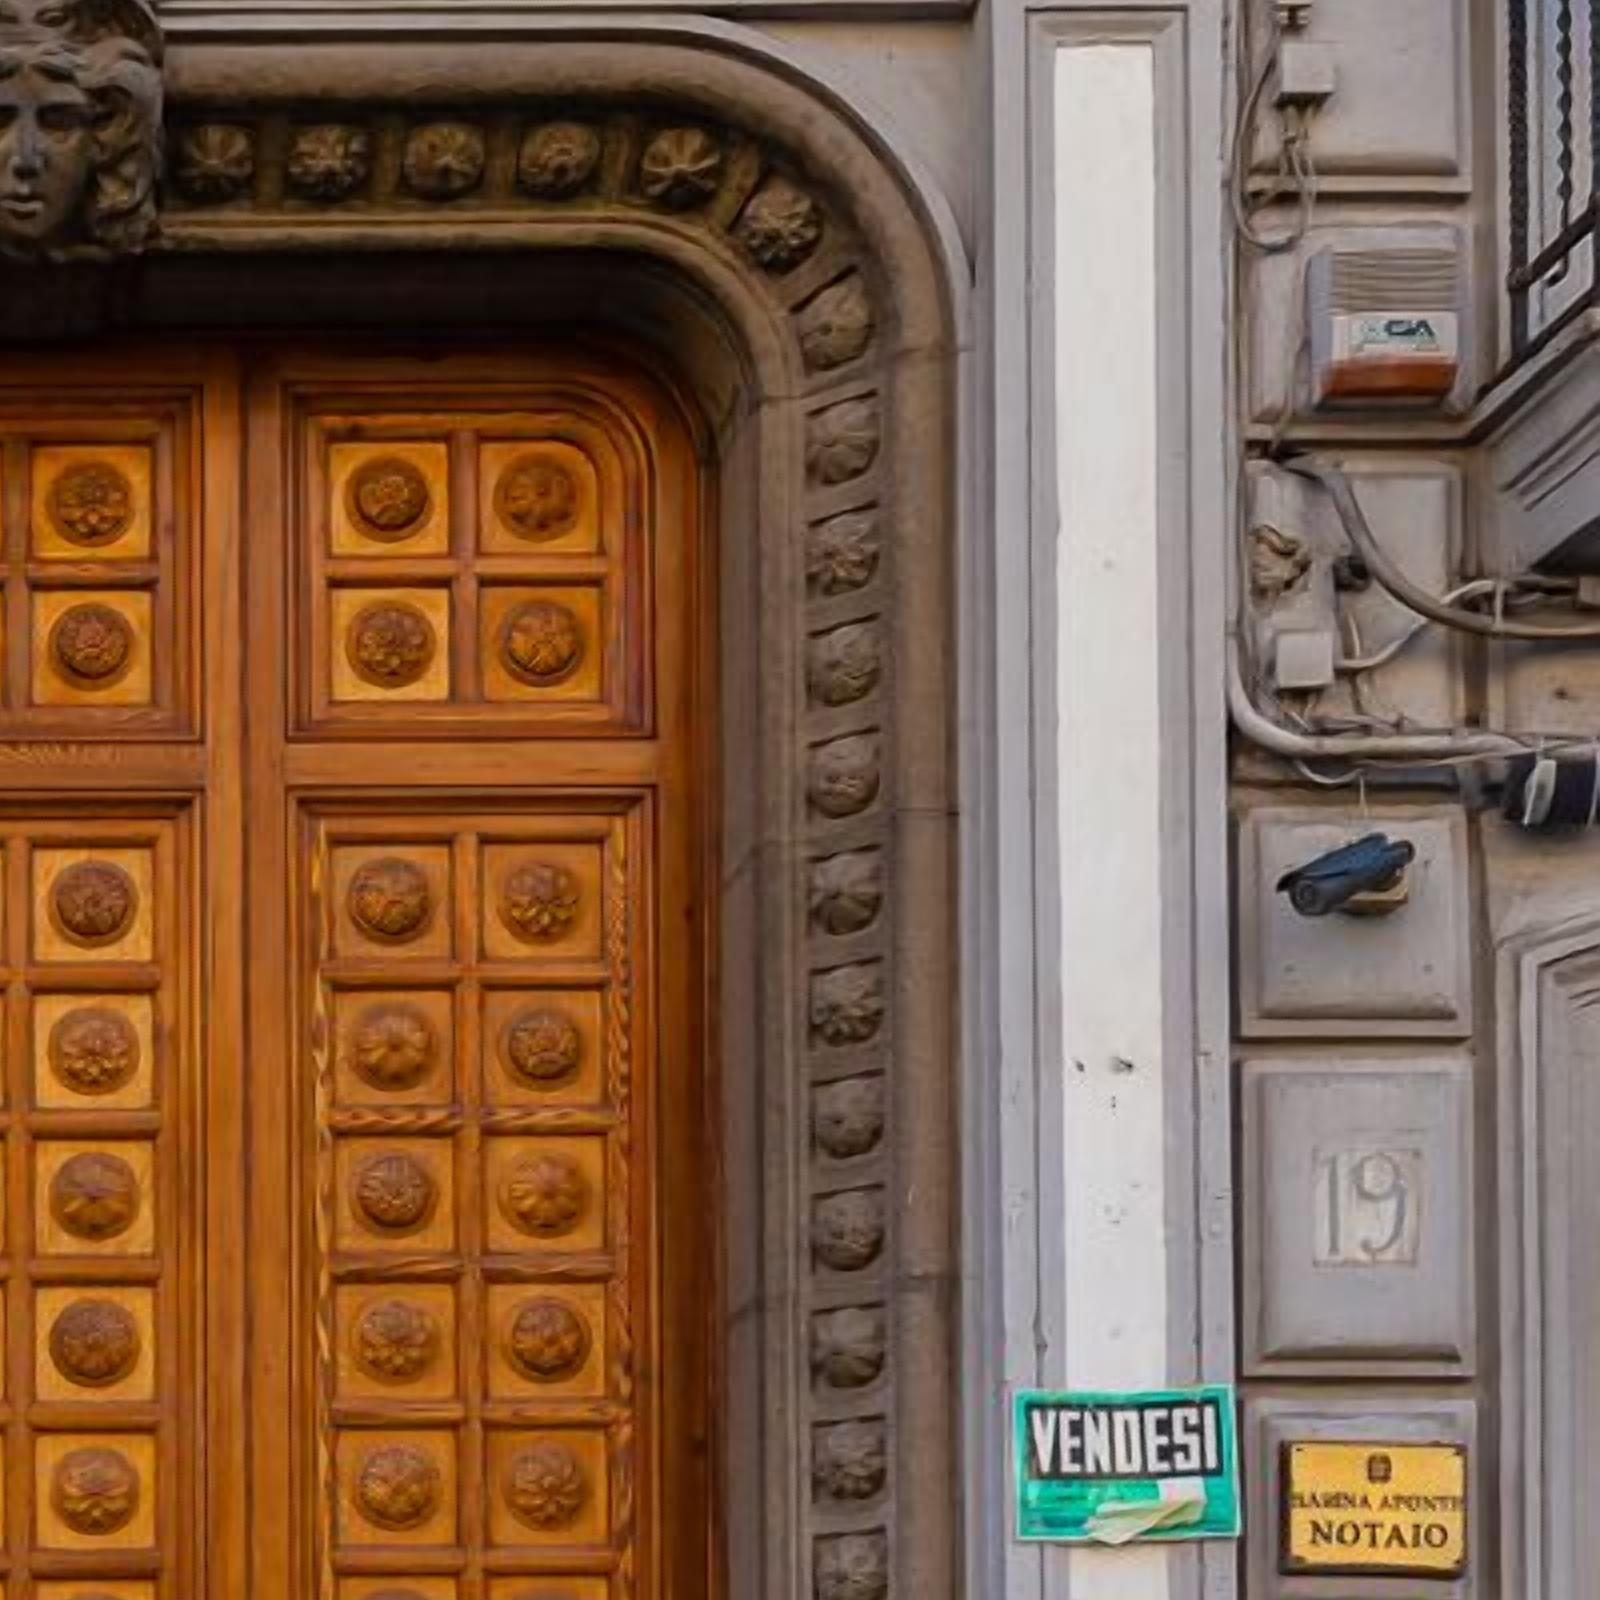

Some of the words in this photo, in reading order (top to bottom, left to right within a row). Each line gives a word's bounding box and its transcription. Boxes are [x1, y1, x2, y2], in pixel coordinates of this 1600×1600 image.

[1328, 1153, 1407, 1254] 19
[1031, 1405, 1218, 1473] VENDESI
[1309, 1521, 1448, 1548] NOTAIO
